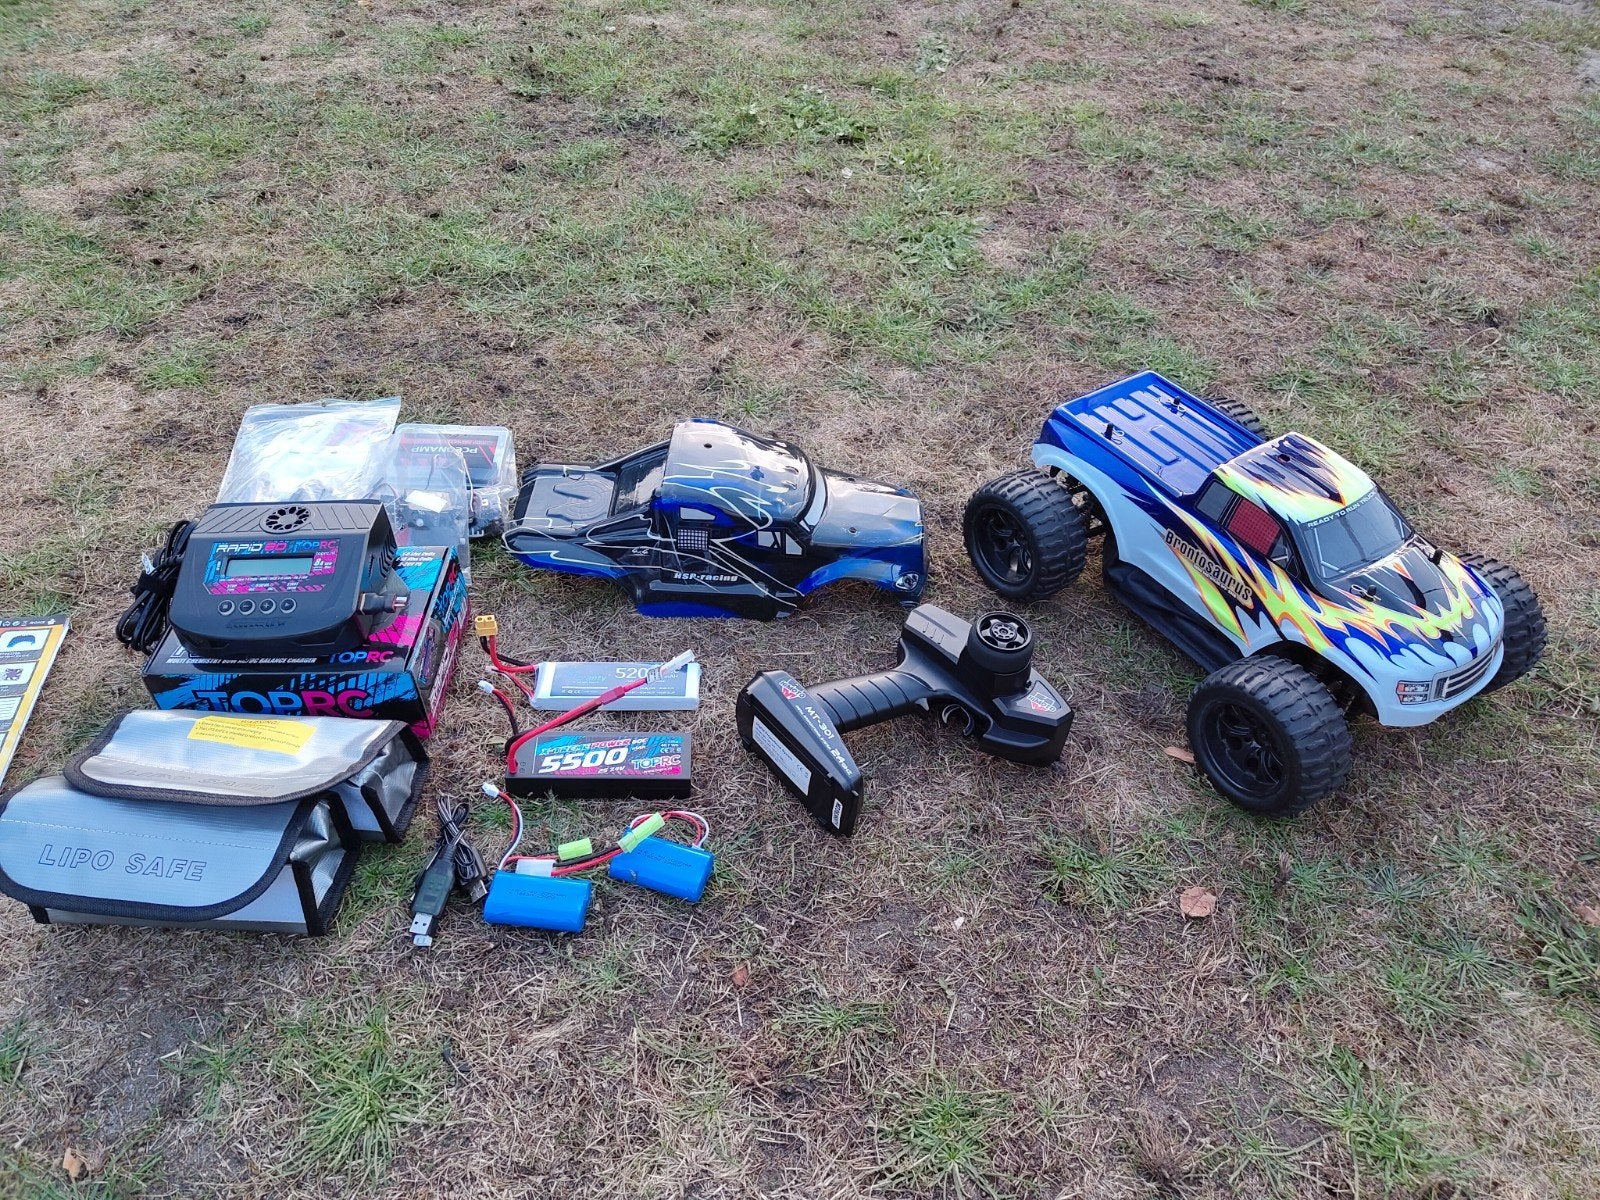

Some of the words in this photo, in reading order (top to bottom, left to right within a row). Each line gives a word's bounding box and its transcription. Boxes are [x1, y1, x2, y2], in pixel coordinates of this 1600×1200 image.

[1307, 514, 1334, 528] READY
[1334, 509, 1346, 518] TO
[1345, 503, 1361, 514] RUN
[294, 540, 337, 553] TOPRC
[673, 572, 739, 582] HSP-racing
[1165, 530, 1253, 601] Brontosaurus
[329, 650, 394, 665] TOPRC
[195, 689, 375, 719] TOPRC
[804, 706, 835, 740] MT-301
[538, 747, 629, 774] 5500
[631, 754, 682, 770] TOPRC
[38, 843, 116, 872] LIPO
[124, 852, 208, 882] SAFE
